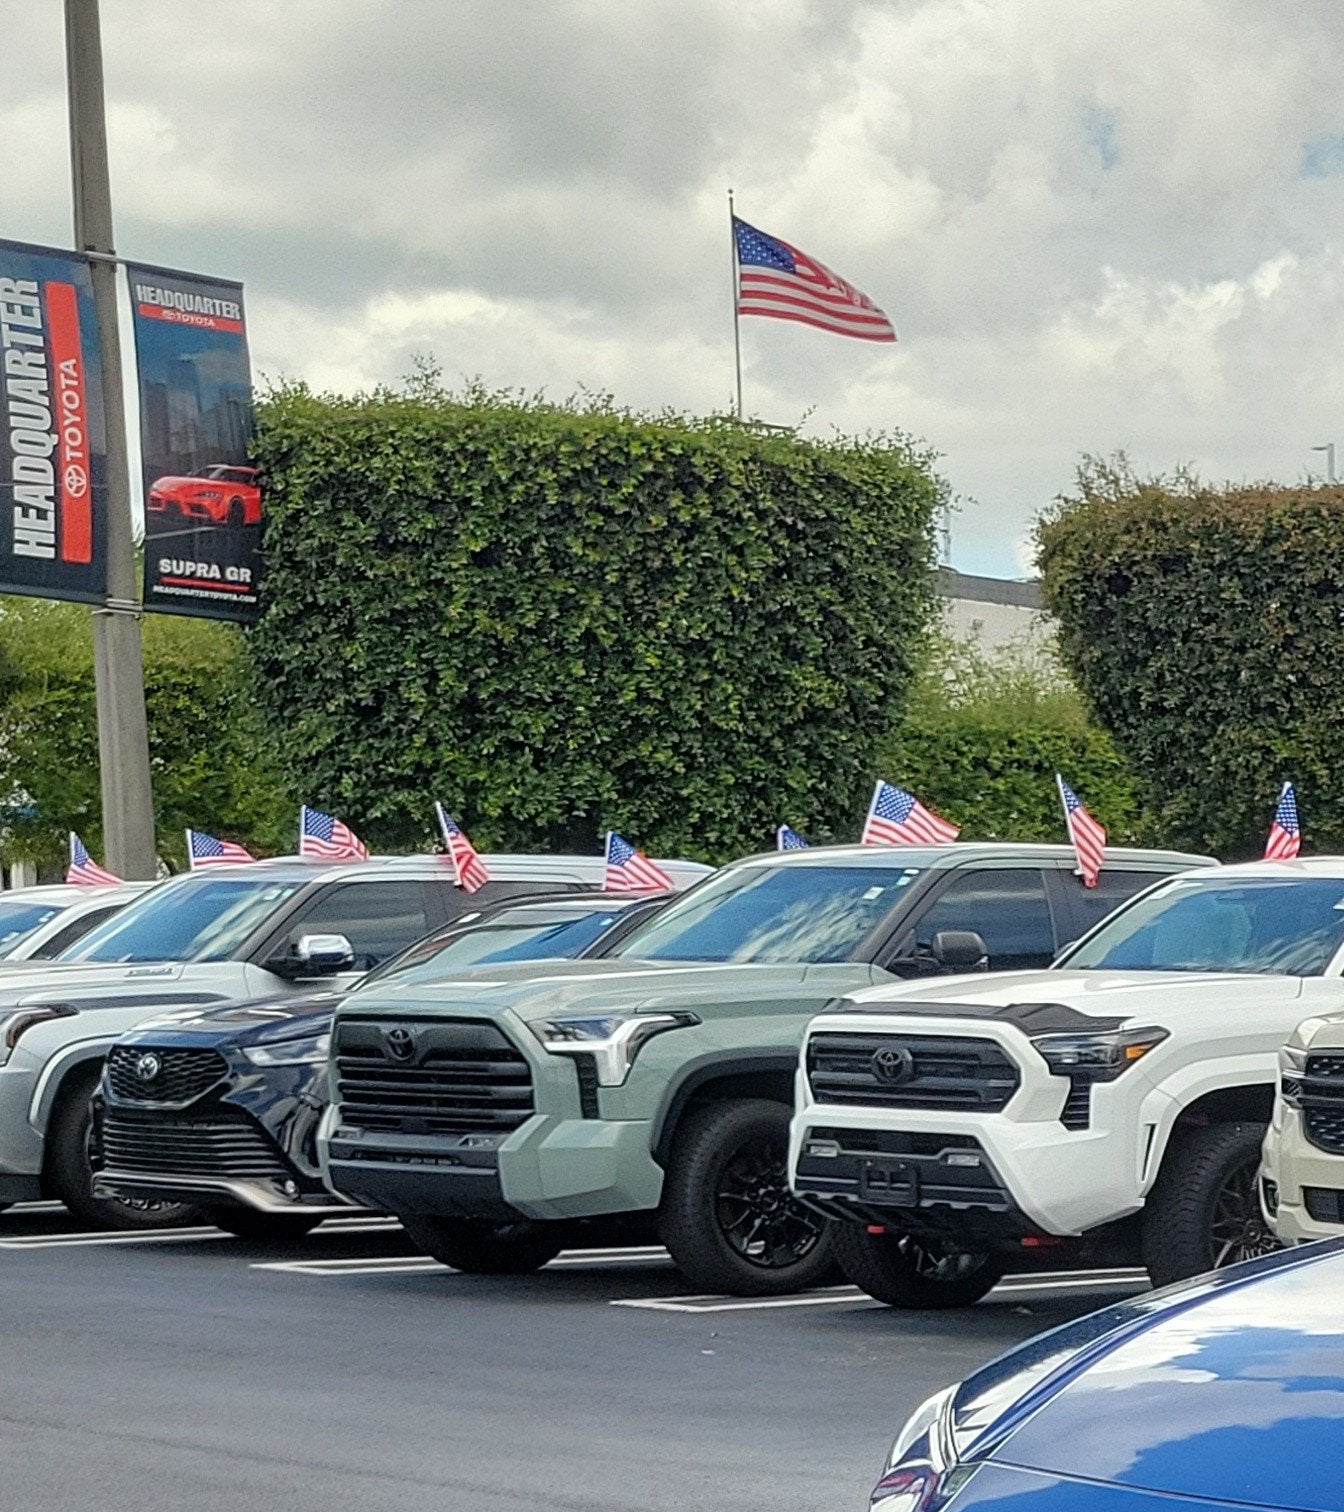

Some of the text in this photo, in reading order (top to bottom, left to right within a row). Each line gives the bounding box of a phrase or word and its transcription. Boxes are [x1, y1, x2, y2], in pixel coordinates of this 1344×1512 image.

[135, 284, 241, 320] HEADQUARTER
[177, 311, 216, 327] TOYOTA
[0, 276, 60, 560] HEADQUARTER
[59, 357, 83, 463] TOYOTA
[159, 558, 252, 583] SUPRA GR
